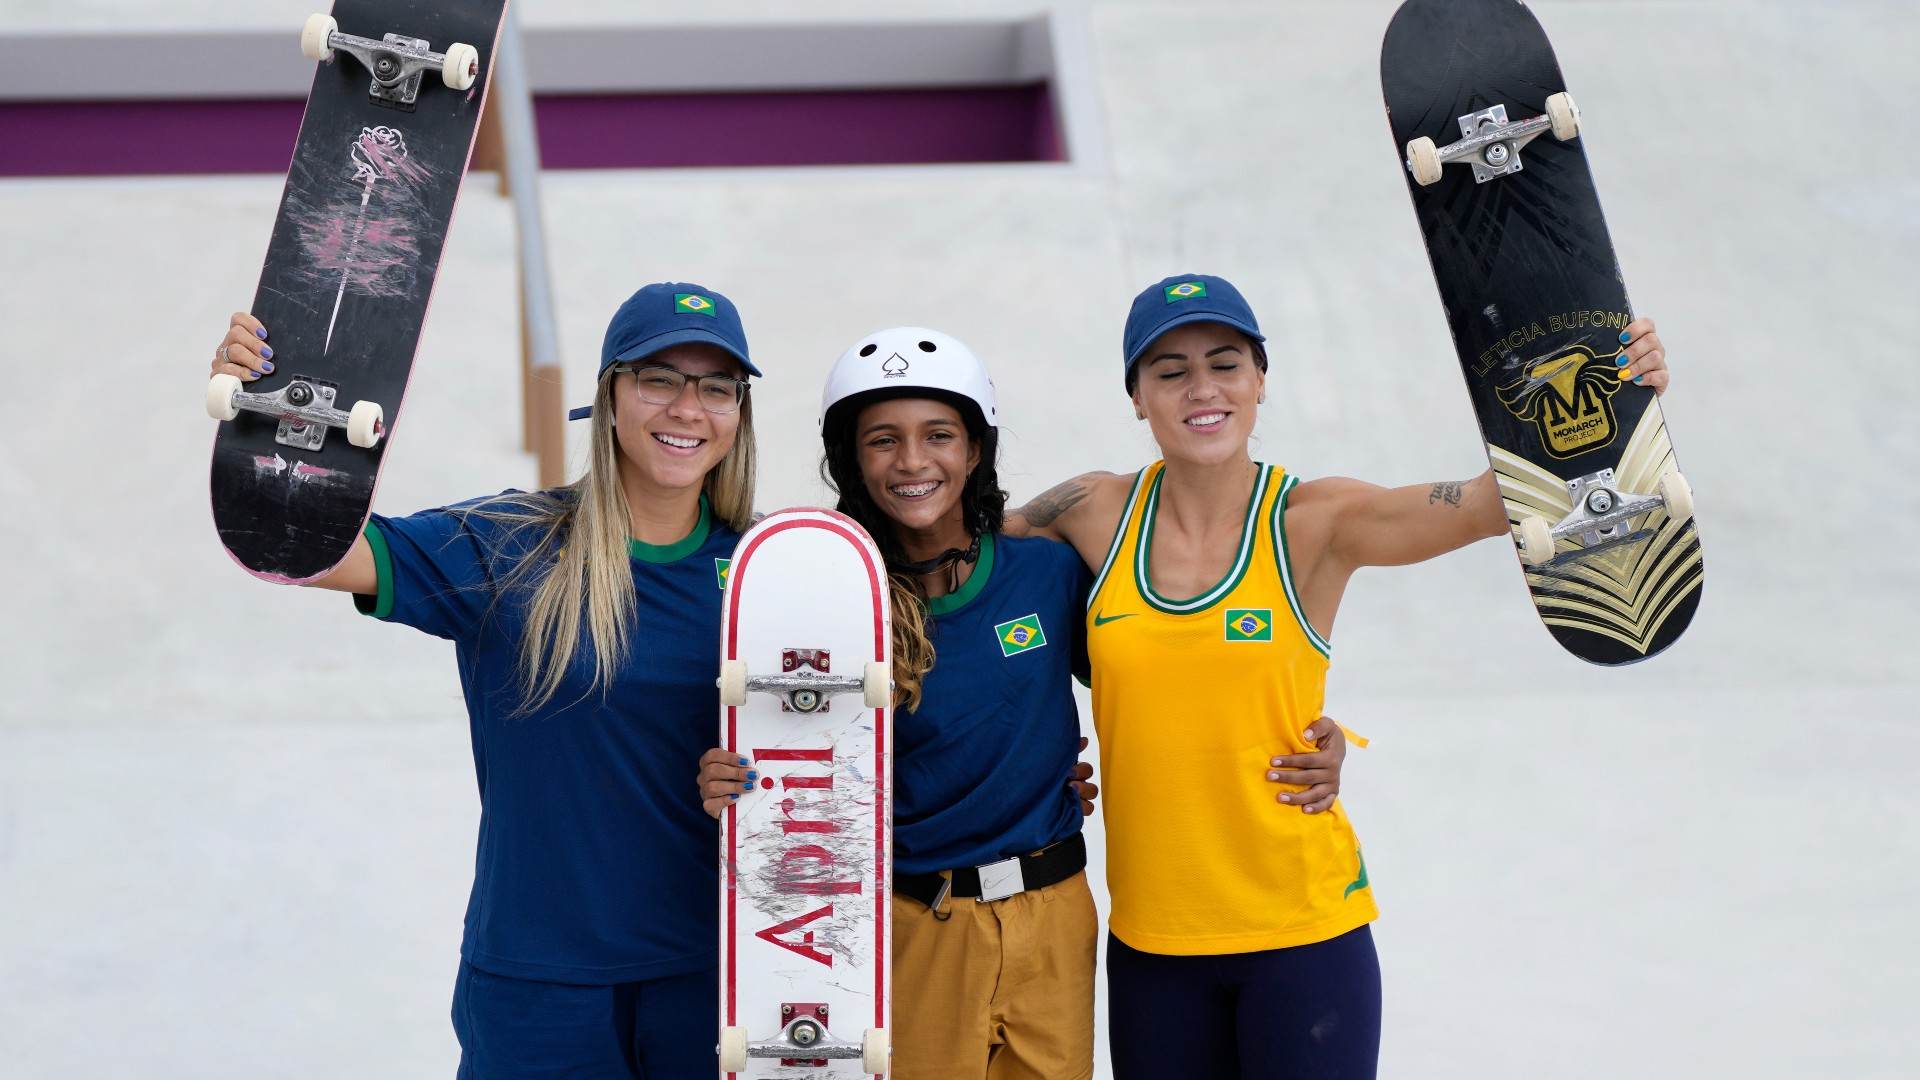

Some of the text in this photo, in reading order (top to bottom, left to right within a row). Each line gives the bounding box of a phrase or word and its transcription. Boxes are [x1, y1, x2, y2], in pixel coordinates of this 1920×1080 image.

[1471, 310, 1629, 378] LETICIA BUFONI
[1553, 417, 1603, 439] MONARCH
[1564, 429, 1596, 443] PROJECT
[752, 745, 862, 969] April
